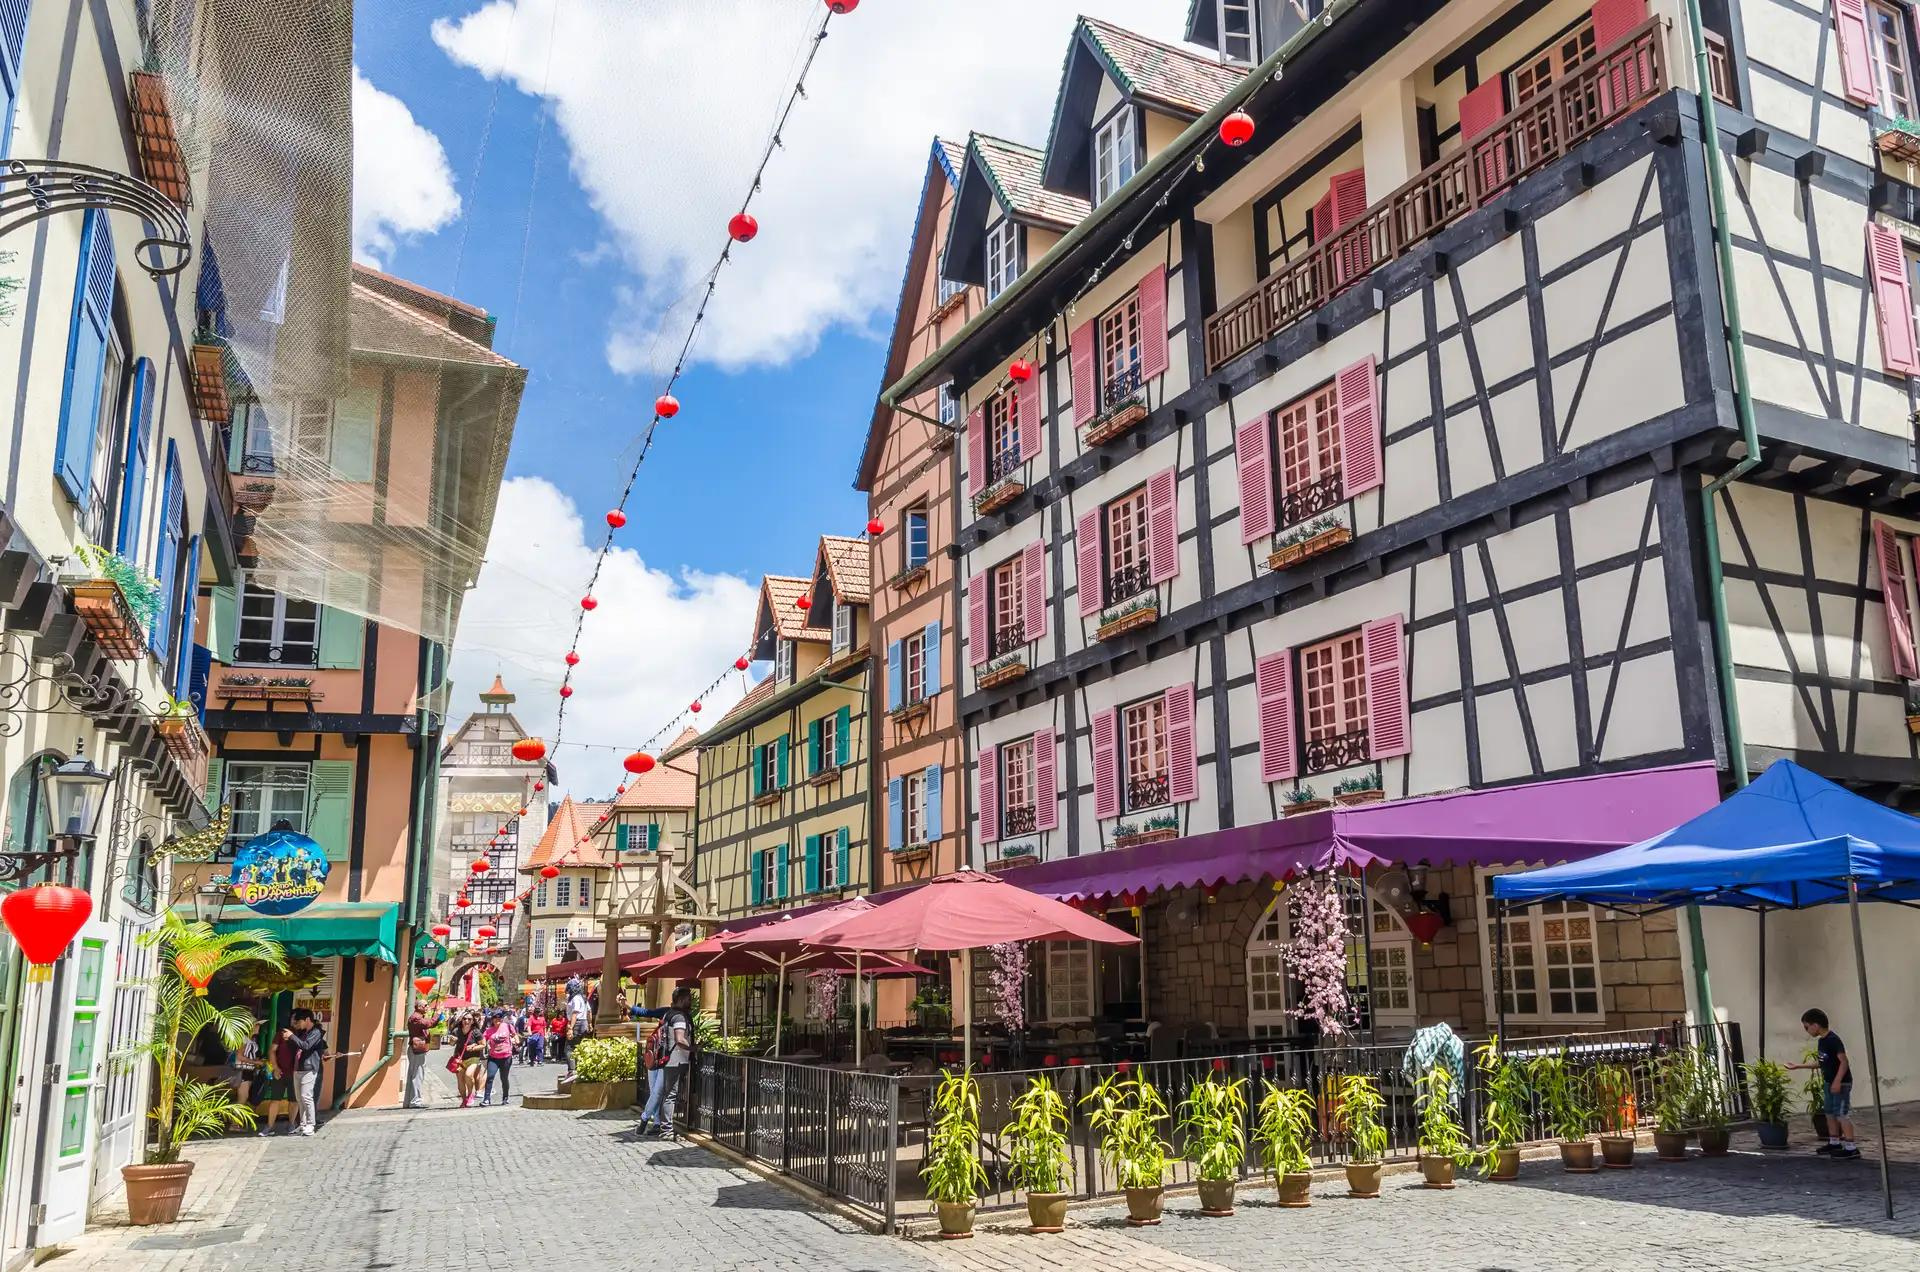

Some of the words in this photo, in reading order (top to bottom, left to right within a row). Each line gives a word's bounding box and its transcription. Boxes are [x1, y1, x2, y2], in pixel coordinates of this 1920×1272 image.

[245, 884, 269, 904] 6D
[269, 881, 293, 890] MOTION
[269, 886, 317, 898] ADVENTURE
[314, 999, 330, 1010] HERE
